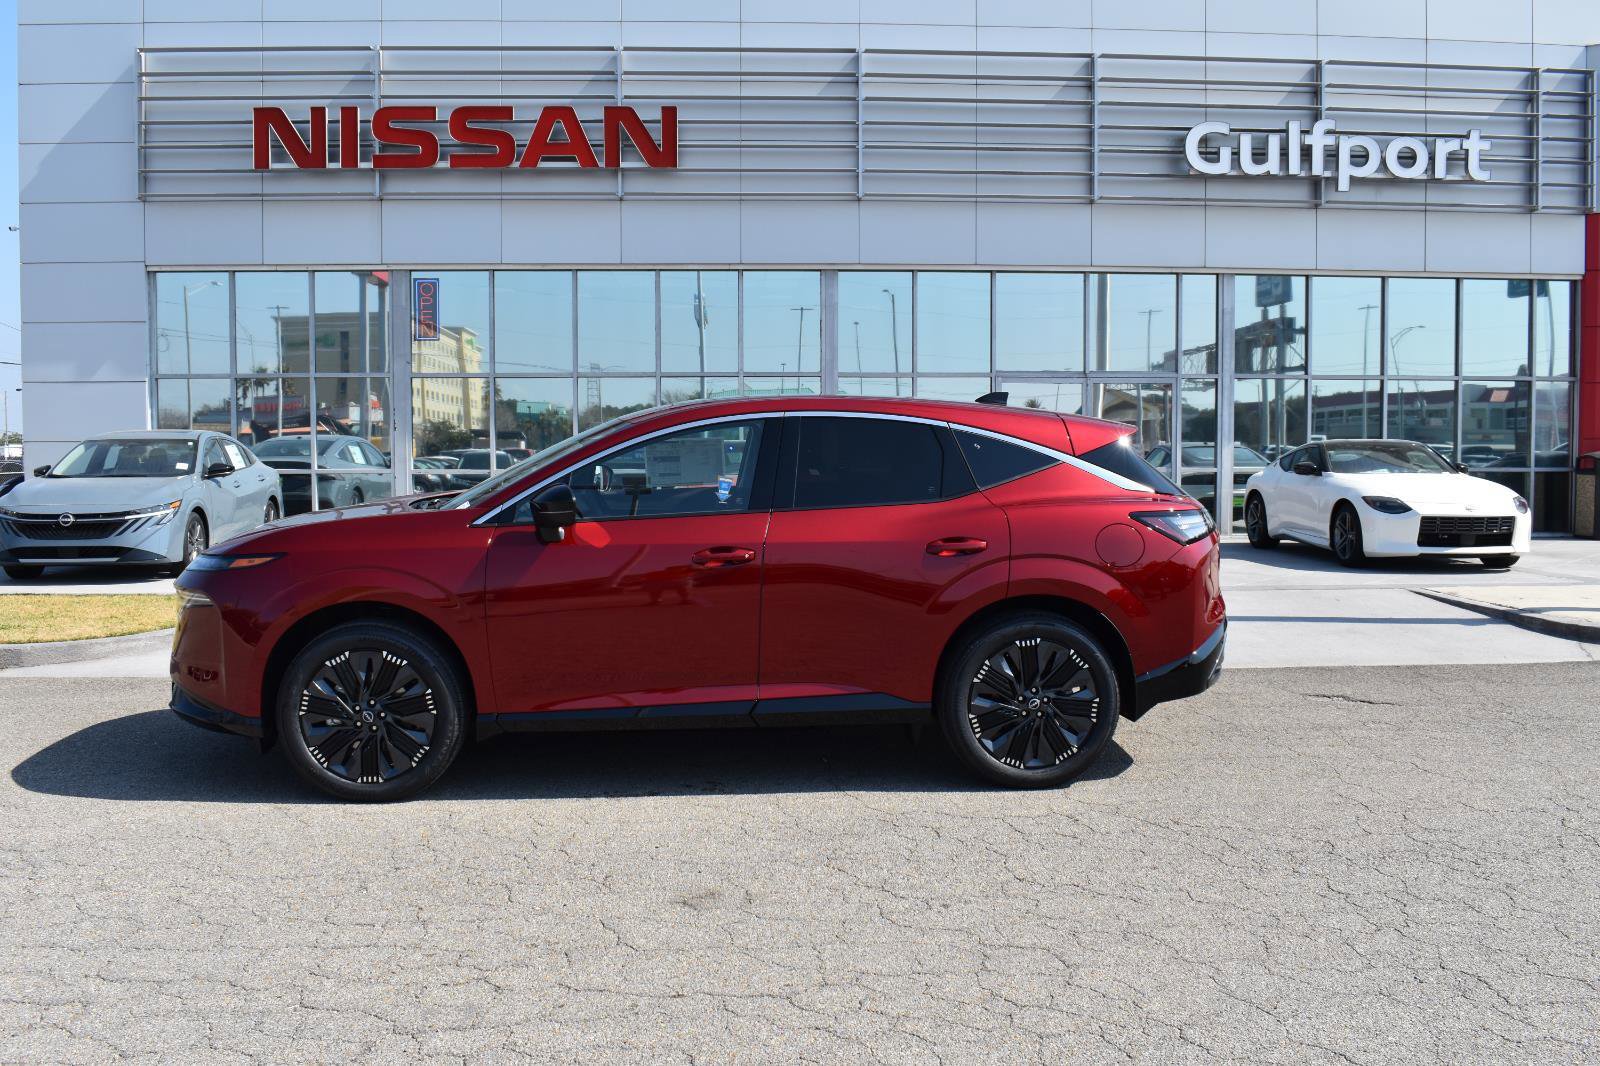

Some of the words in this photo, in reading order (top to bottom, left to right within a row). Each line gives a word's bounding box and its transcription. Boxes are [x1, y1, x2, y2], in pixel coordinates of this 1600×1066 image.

[253, 105, 678, 169] NISSAN
[1185, 118, 1492, 192] Gulfport
[420, 283, 434, 337] OPEN
